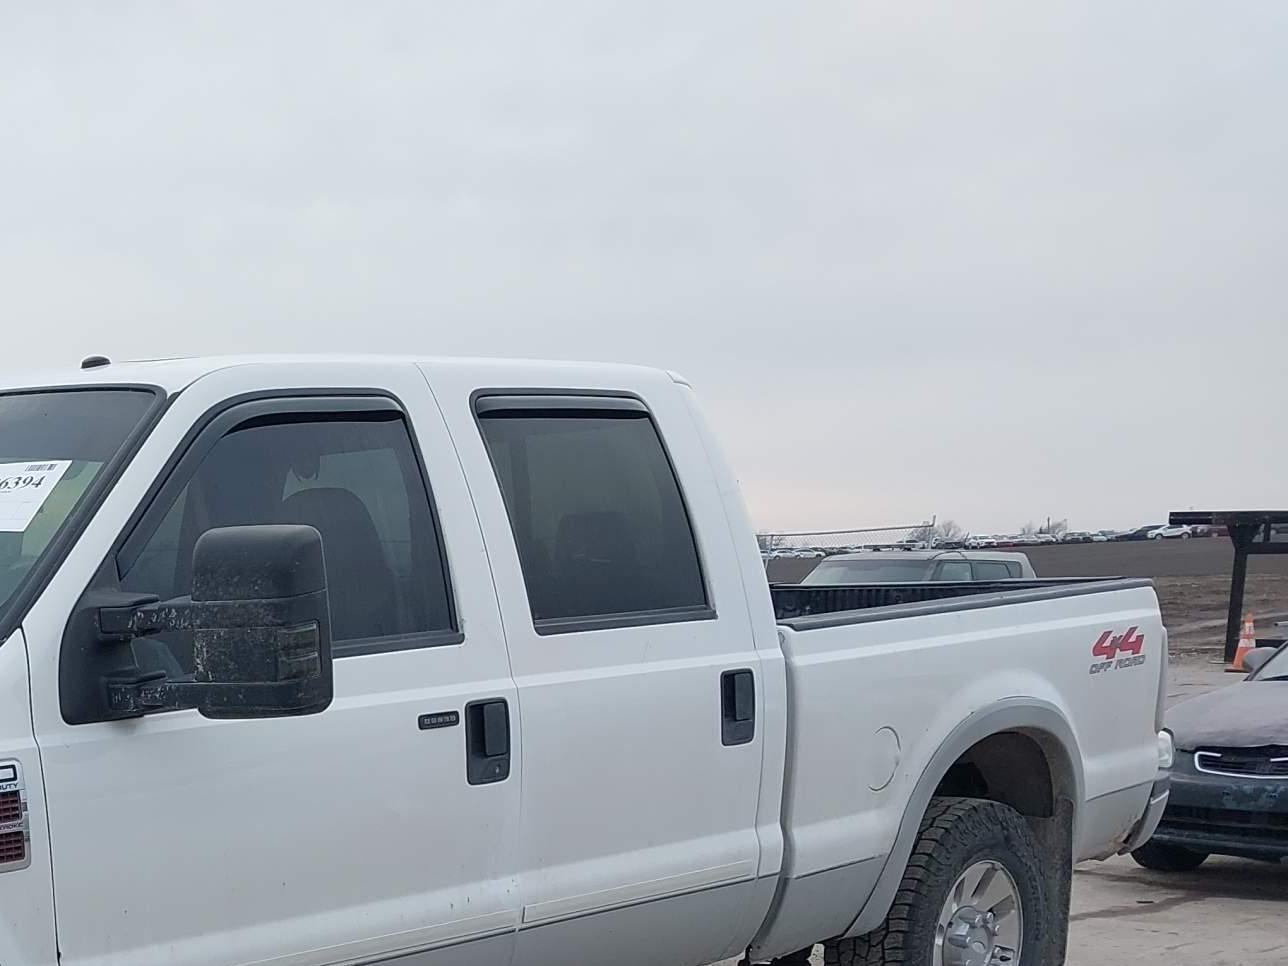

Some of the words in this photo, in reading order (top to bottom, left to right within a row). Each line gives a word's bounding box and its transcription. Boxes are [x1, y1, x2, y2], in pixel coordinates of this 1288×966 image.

[1092, 626, 1144, 660] 4x4
[1089, 661, 1113, 675] OFF
[1115, 654, 1146, 670] ROAD
